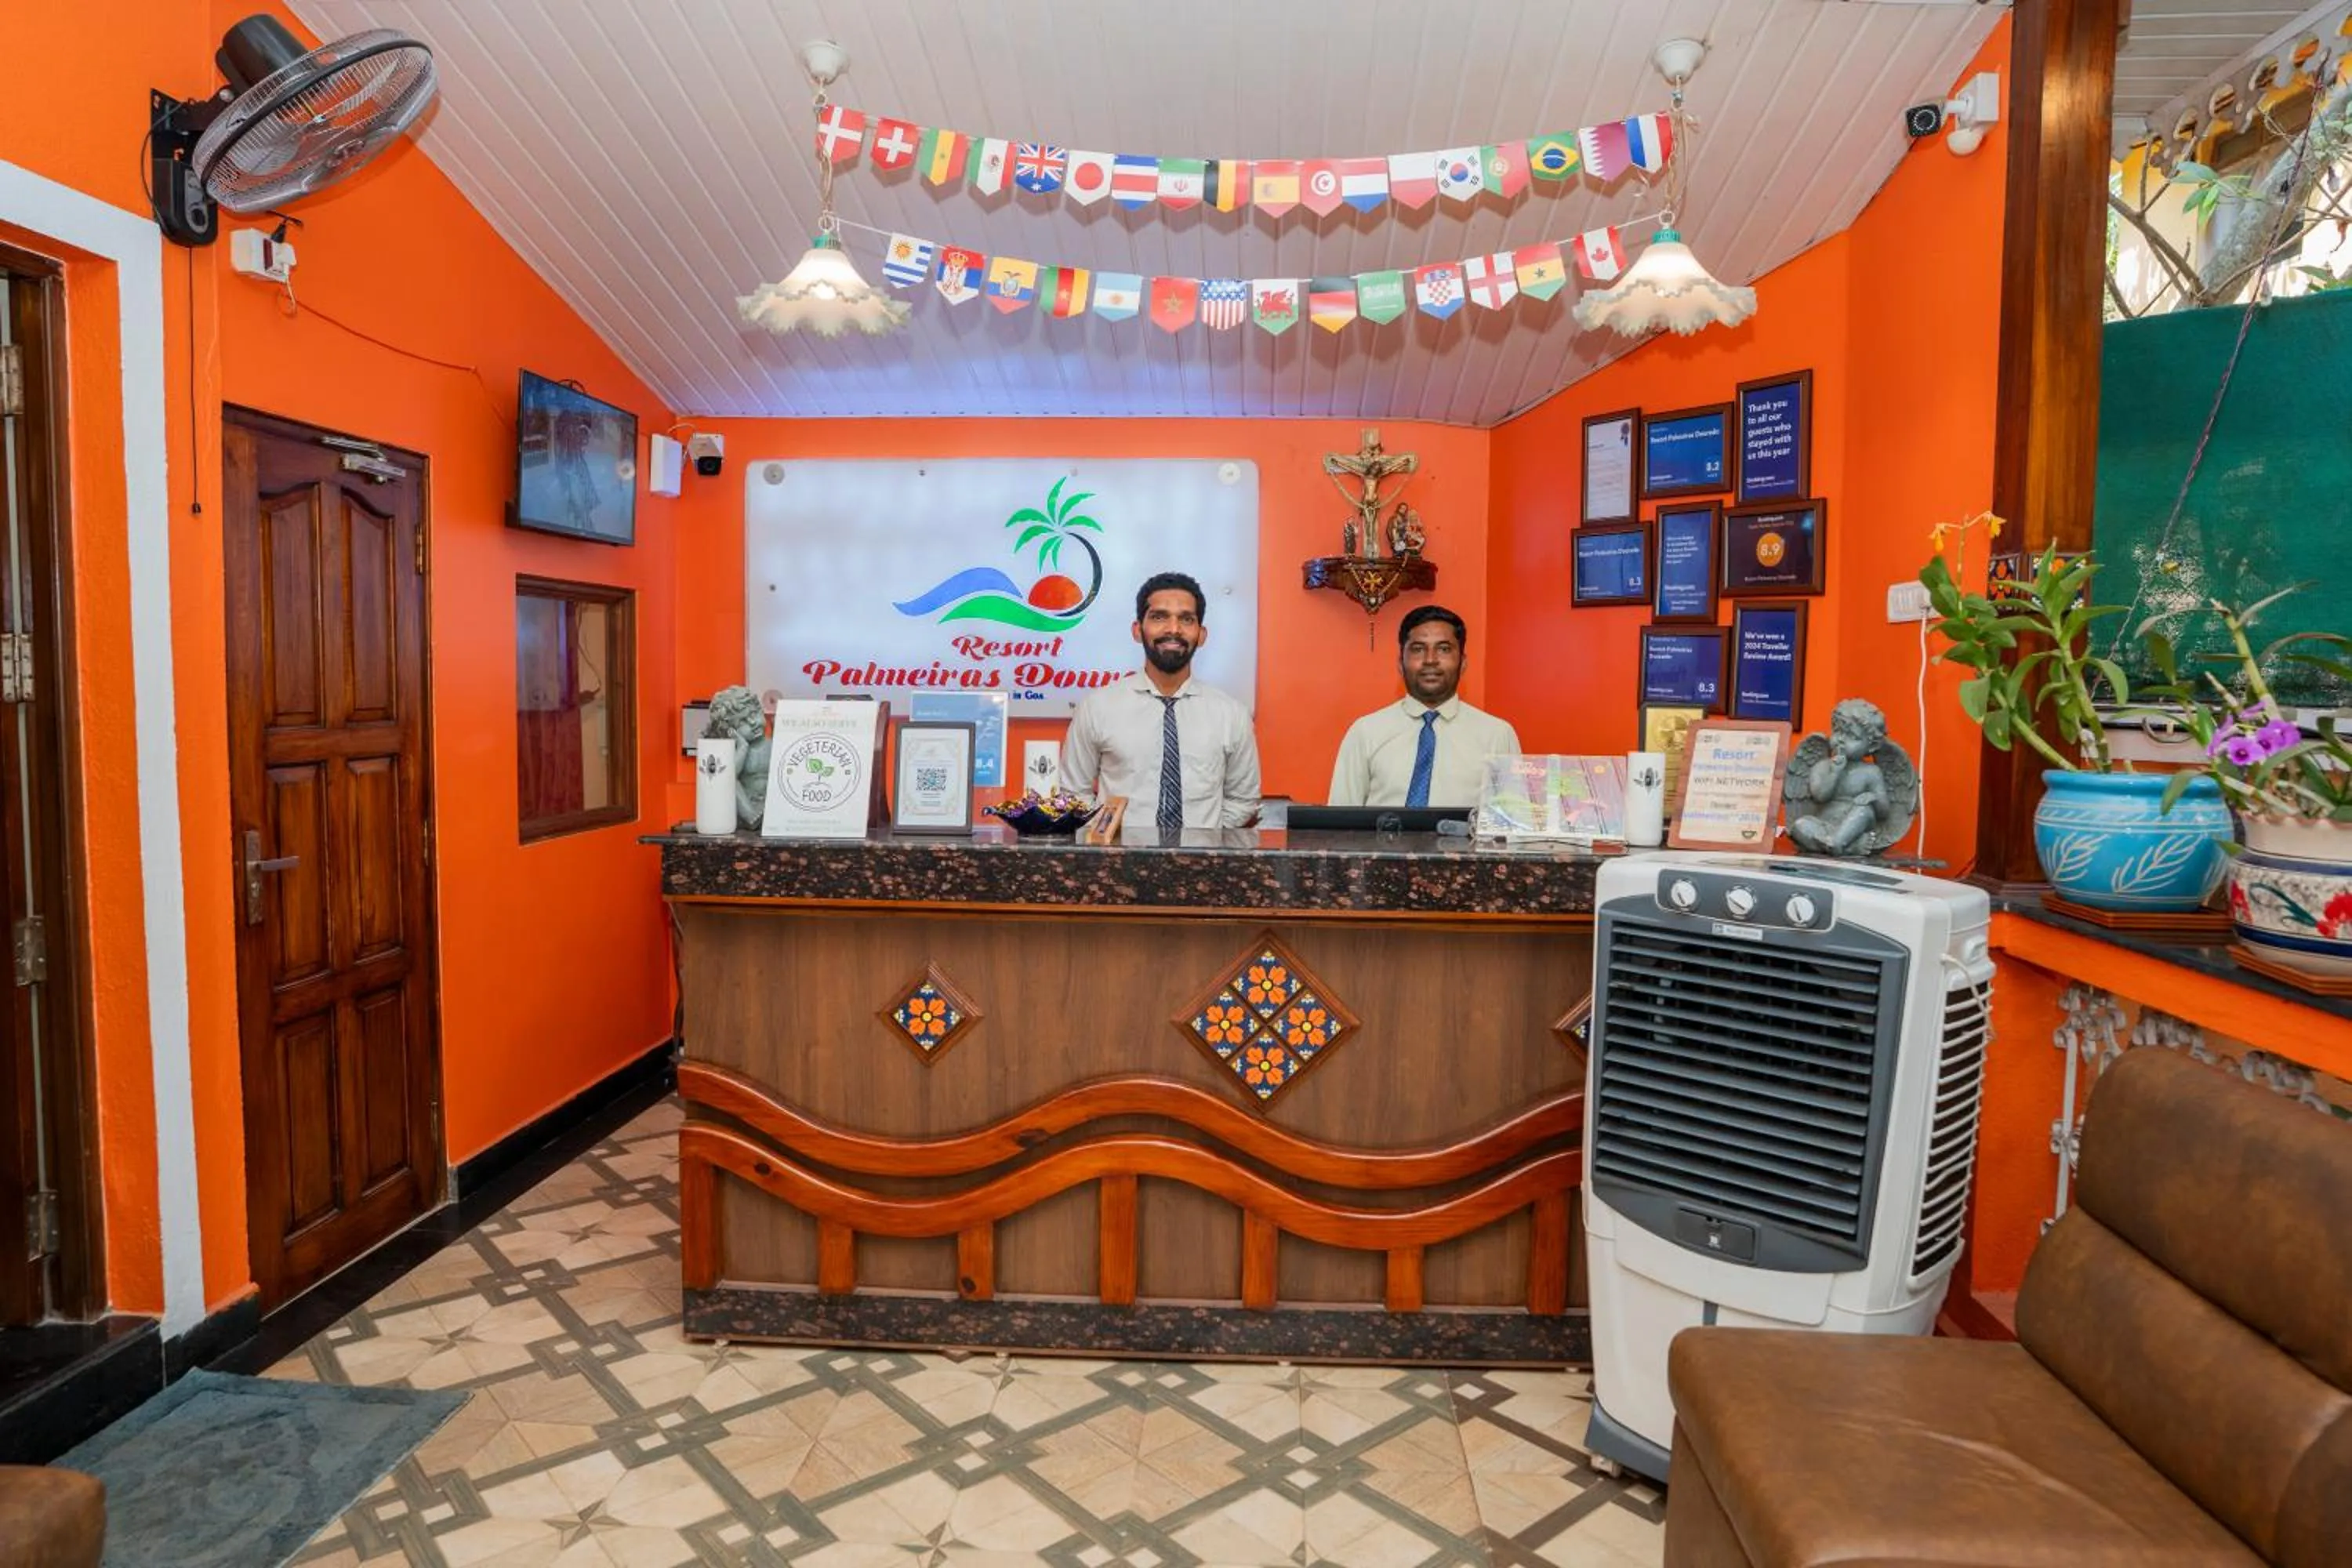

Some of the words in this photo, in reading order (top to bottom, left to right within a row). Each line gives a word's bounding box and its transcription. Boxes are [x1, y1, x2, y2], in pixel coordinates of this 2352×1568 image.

[1748, 402, 1771, 413] Thank
[1773, 401, 1788, 411] you
[1758, 414, 1767, 423] all
[1769, 412, 1782, 421] our
[1748, 427, 1773, 438] guests
[1774, 423, 1791, 432] who
[1748, 437, 1773, 449] stayed
[1774, 434, 1791, 444] with
[1748, 452, 1756, 460] us
[1758, 449, 1771, 459] this
[1773, 448, 1791, 459] year
[1760, 543, 1781, 556] 8.9
[952, 634, 1063, 661] Resort
[1762, 642, 1789, 651] Traveller
[802, 659, 1001, 688] Palmeiras
[1014, 662, 1136, 688] Dour
[1698, 682, 1715, 692] 8.3
[1024, 690, 1045, 700] Goa
[787, 741, 852, 768] VEGETERIAN
[1713, 747, 1755, 760] Resort
[1715, 777, 1766, 787] NETWORK
[801, 789, 832, 802] FOOD
